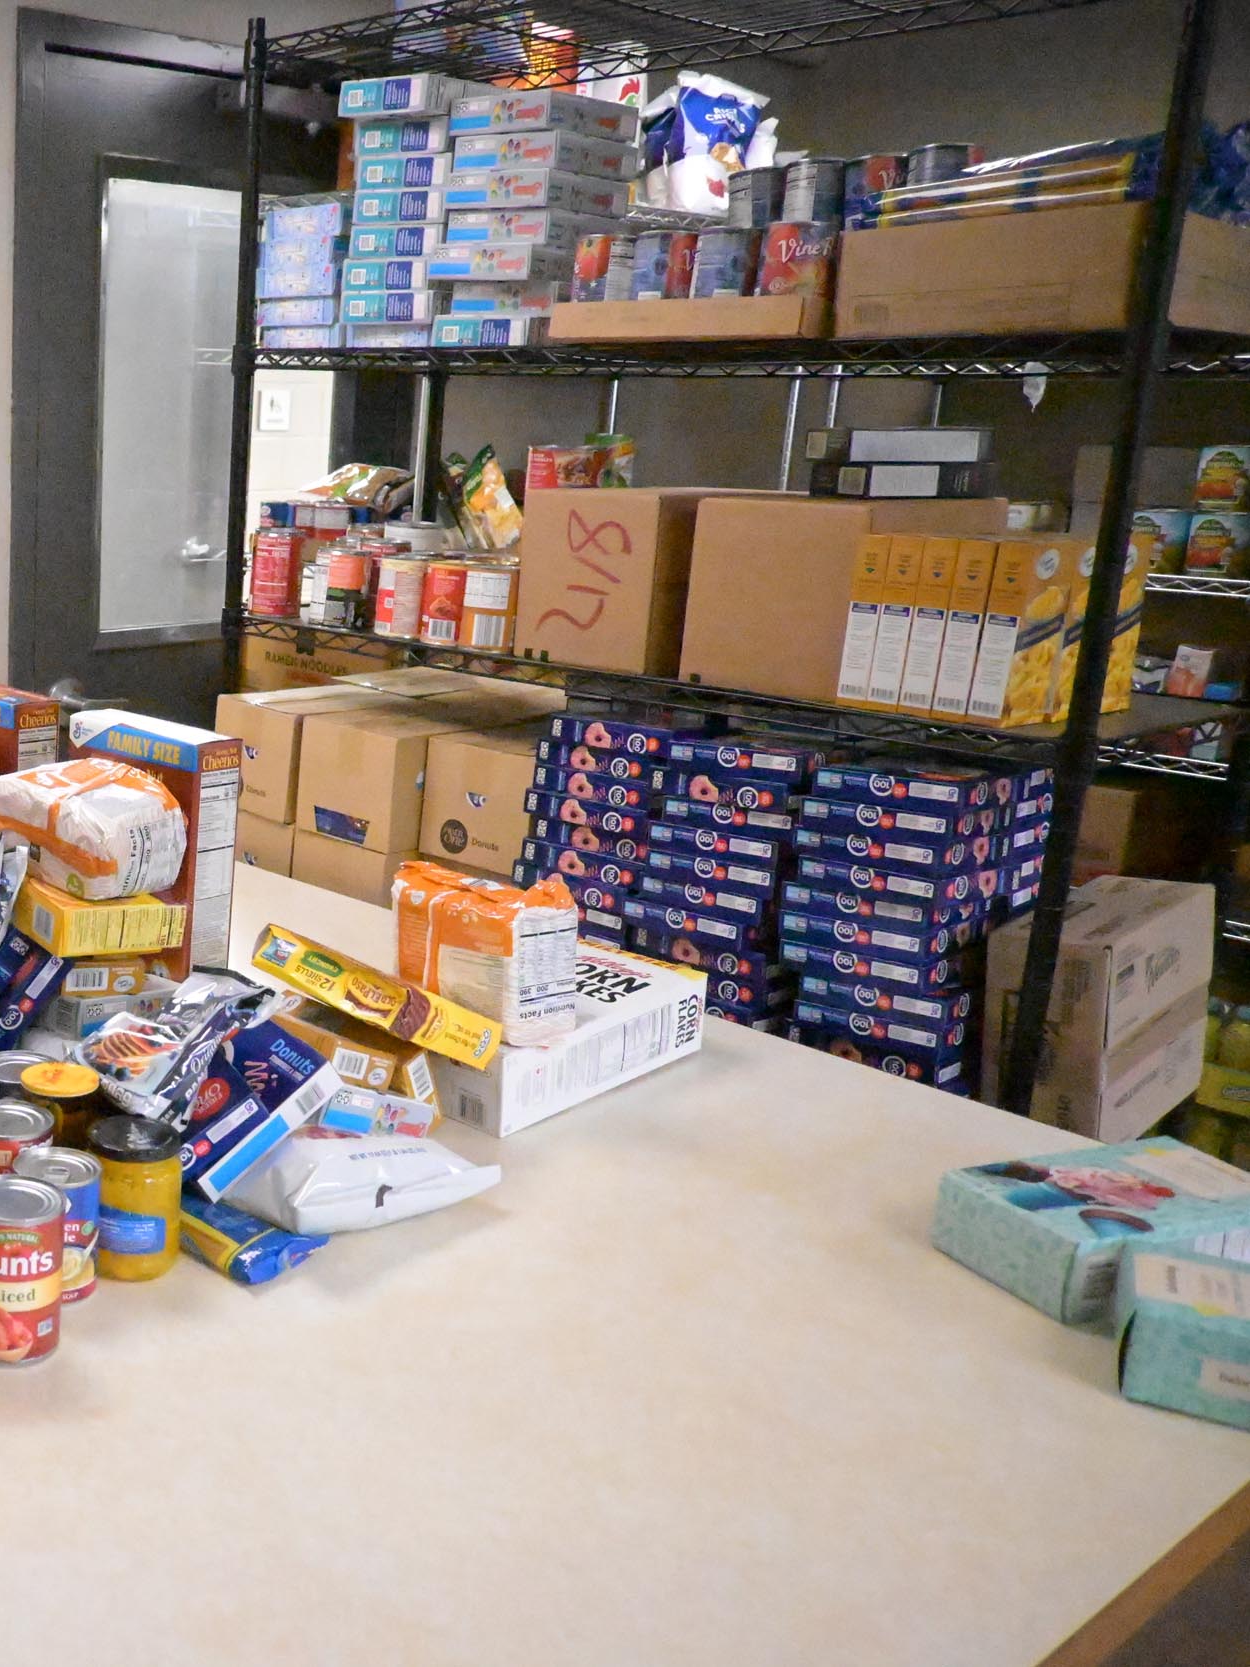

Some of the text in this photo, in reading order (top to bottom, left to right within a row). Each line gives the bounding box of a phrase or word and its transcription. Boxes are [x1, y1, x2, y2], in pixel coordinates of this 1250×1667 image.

[19, 713, 57, 728] Cheerios
[107, 731, 181, 765] FAMILY SIZE
[202, 755, 239, 770] Cheerios
[470, 837, 500, 852] Donuts
[575, 962, 652, 995] ORN
[519, 1002, 575, 1020] Nutrition Facts
[686, 994, 699, 1045] CORN
[674, 998, 688, 1050] FLAKES
[269, 1038, 316, 1077] Donuts
[7, 1232, 39, 1242] NATURAL
